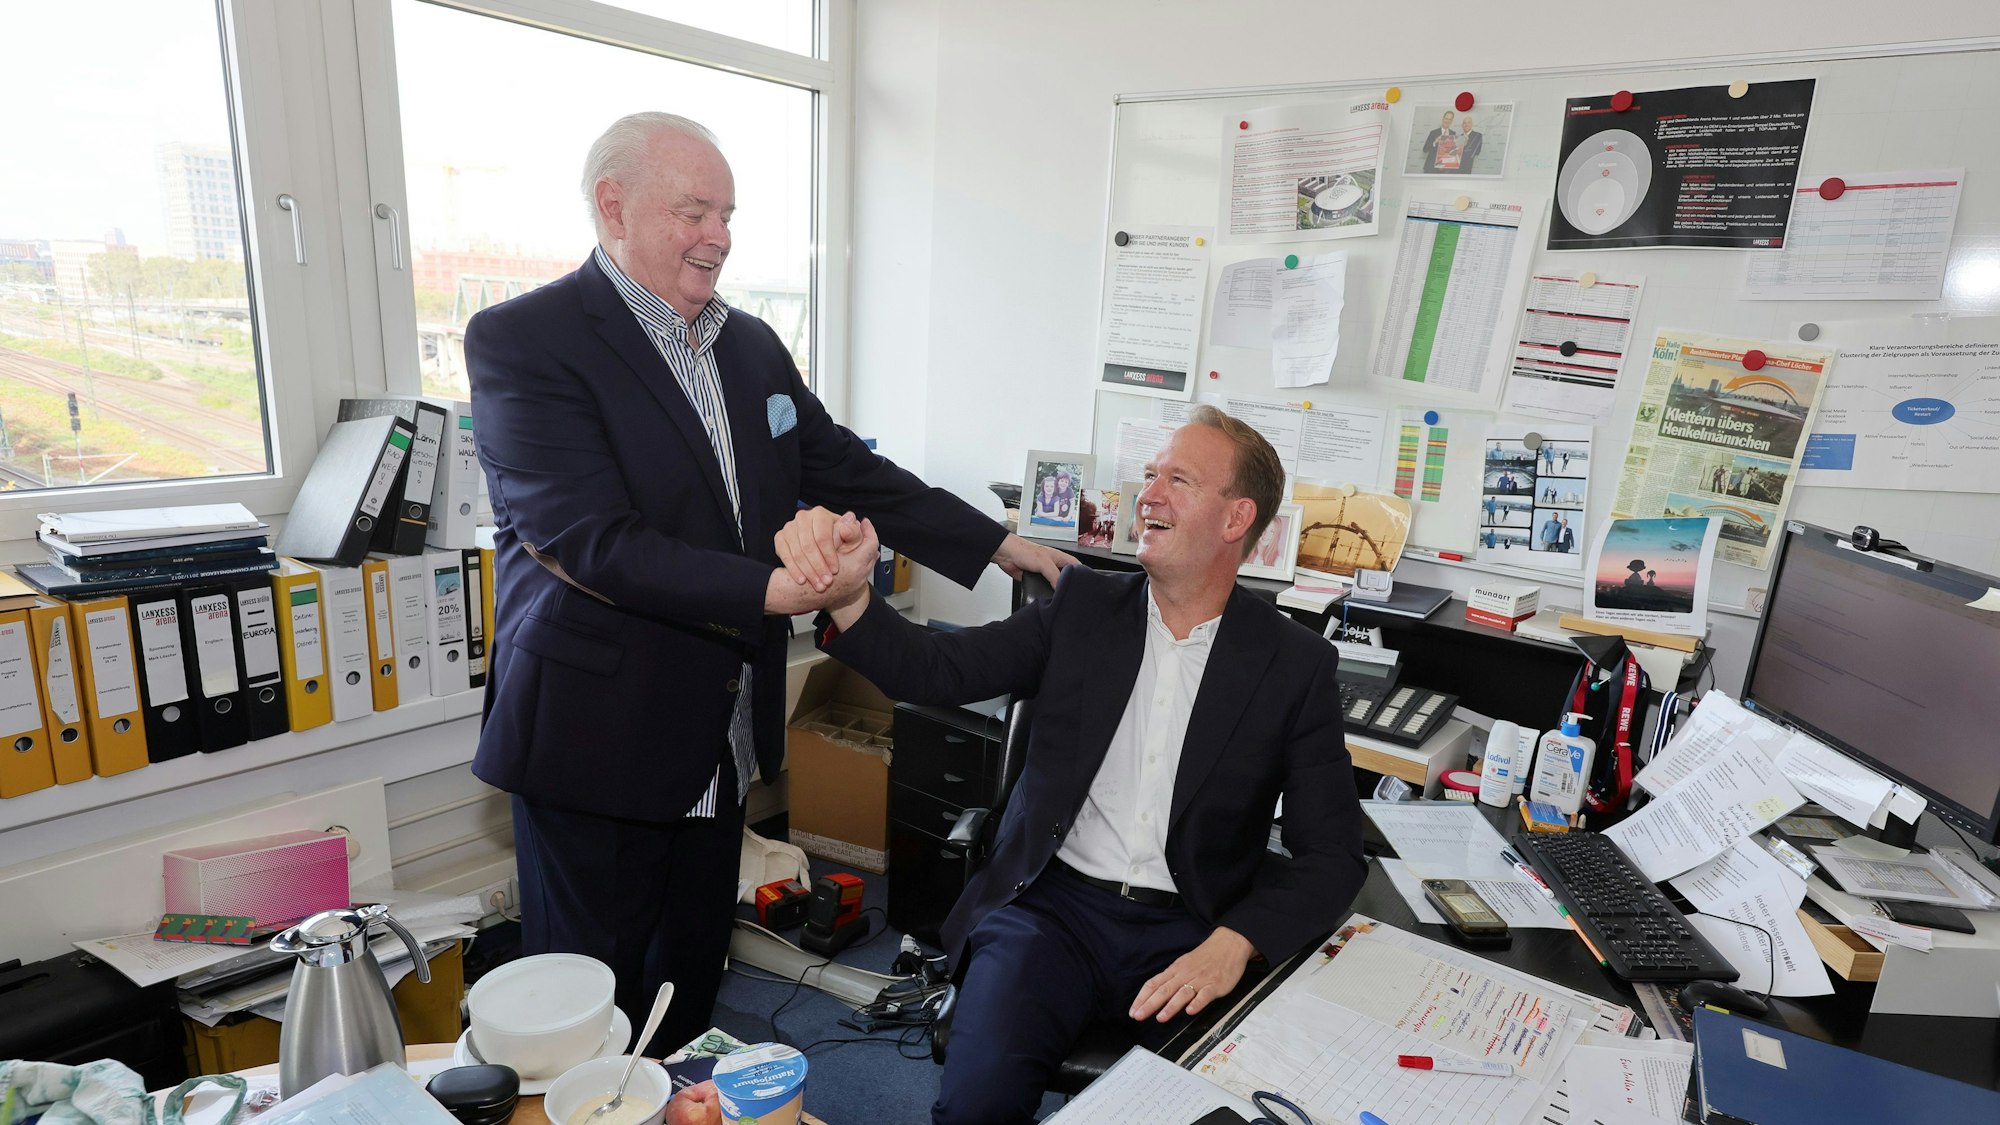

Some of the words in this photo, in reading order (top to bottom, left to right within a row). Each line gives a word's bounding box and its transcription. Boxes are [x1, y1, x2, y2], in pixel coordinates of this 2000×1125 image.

[1371, 102, 1389, 111] arena
[1666, 340, 1680, 349] Hallo
[1887, 343, 1963, 351] Verantwortungsbereiche
[1652, 347, 1679, 361] Köln!
[1124, 371, 1147, 381] LANXESS
[1665, 407, 1716, 427] Klettern
[1717, 415, 1755, 433] übers
[415, 431, 437, 445] Lärm
[460, 435, 473, 445] SKY
[1661, 421, 1771, 451] Henkelmännchen
[458, 449, 477, 457] WALK
[381, 461, 397, 474] WEG
[1475, 588, 1511, 601] mundart
[142, 607, 176, 619] LANXESS
[195, 601, 227, 613] LANXESS
[438, 604, 460, 616] 20%
[155, 615, 177, 626] arena
[208, 610, 229, 620] arena
[243, 627, 276, 639] EUROPA
[1626, 662, 1637, 687] REWE
[1619, 707, 1631, 732] REWE
[1546, 743, 1581, 759] CeraVe
[1487, 751, 1511, 765] Lodivol
[790, 828, 816, 842] RAGILE
[841, 842, 869, 854] FRAGILE
[1741, 901, 1756, 927] mich
[1754, 894, 1772, 926] Jeder
[1767, 917, 1785, 948] Bissen
[1782, 943, 1797, 973] macht
[732, 1069, 796, 1089] Naturjoghurt
